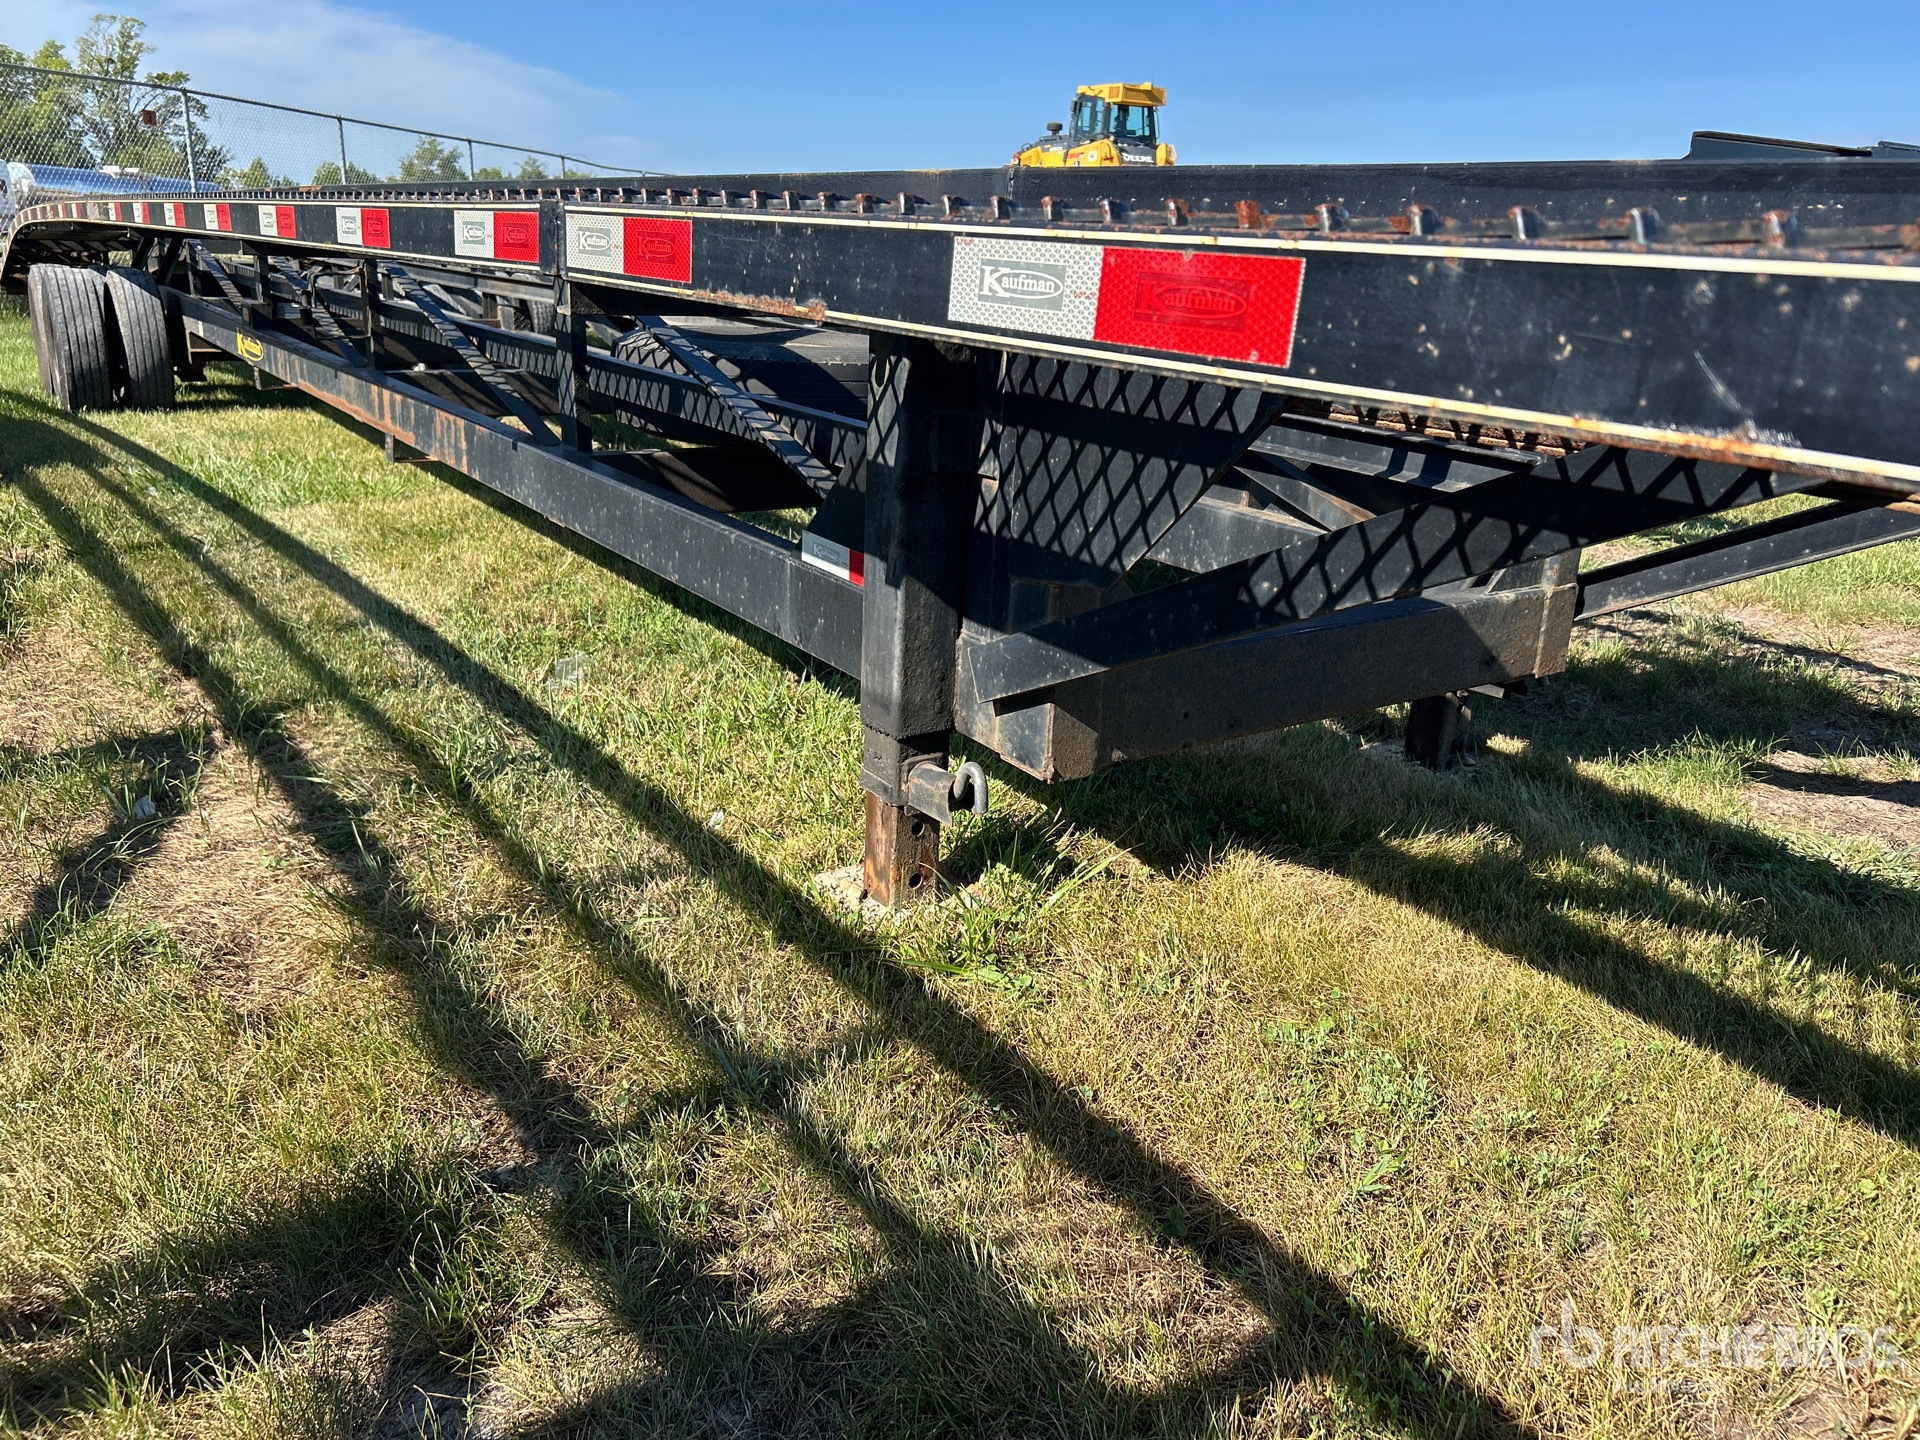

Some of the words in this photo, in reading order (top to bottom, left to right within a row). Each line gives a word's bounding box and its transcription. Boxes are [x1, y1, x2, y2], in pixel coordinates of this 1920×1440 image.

[1121, 152, 1154, 163] DEERE
[979, 264, 1058, 299] Kaufman
[1136, 277, 1240, 317] Kaufman
